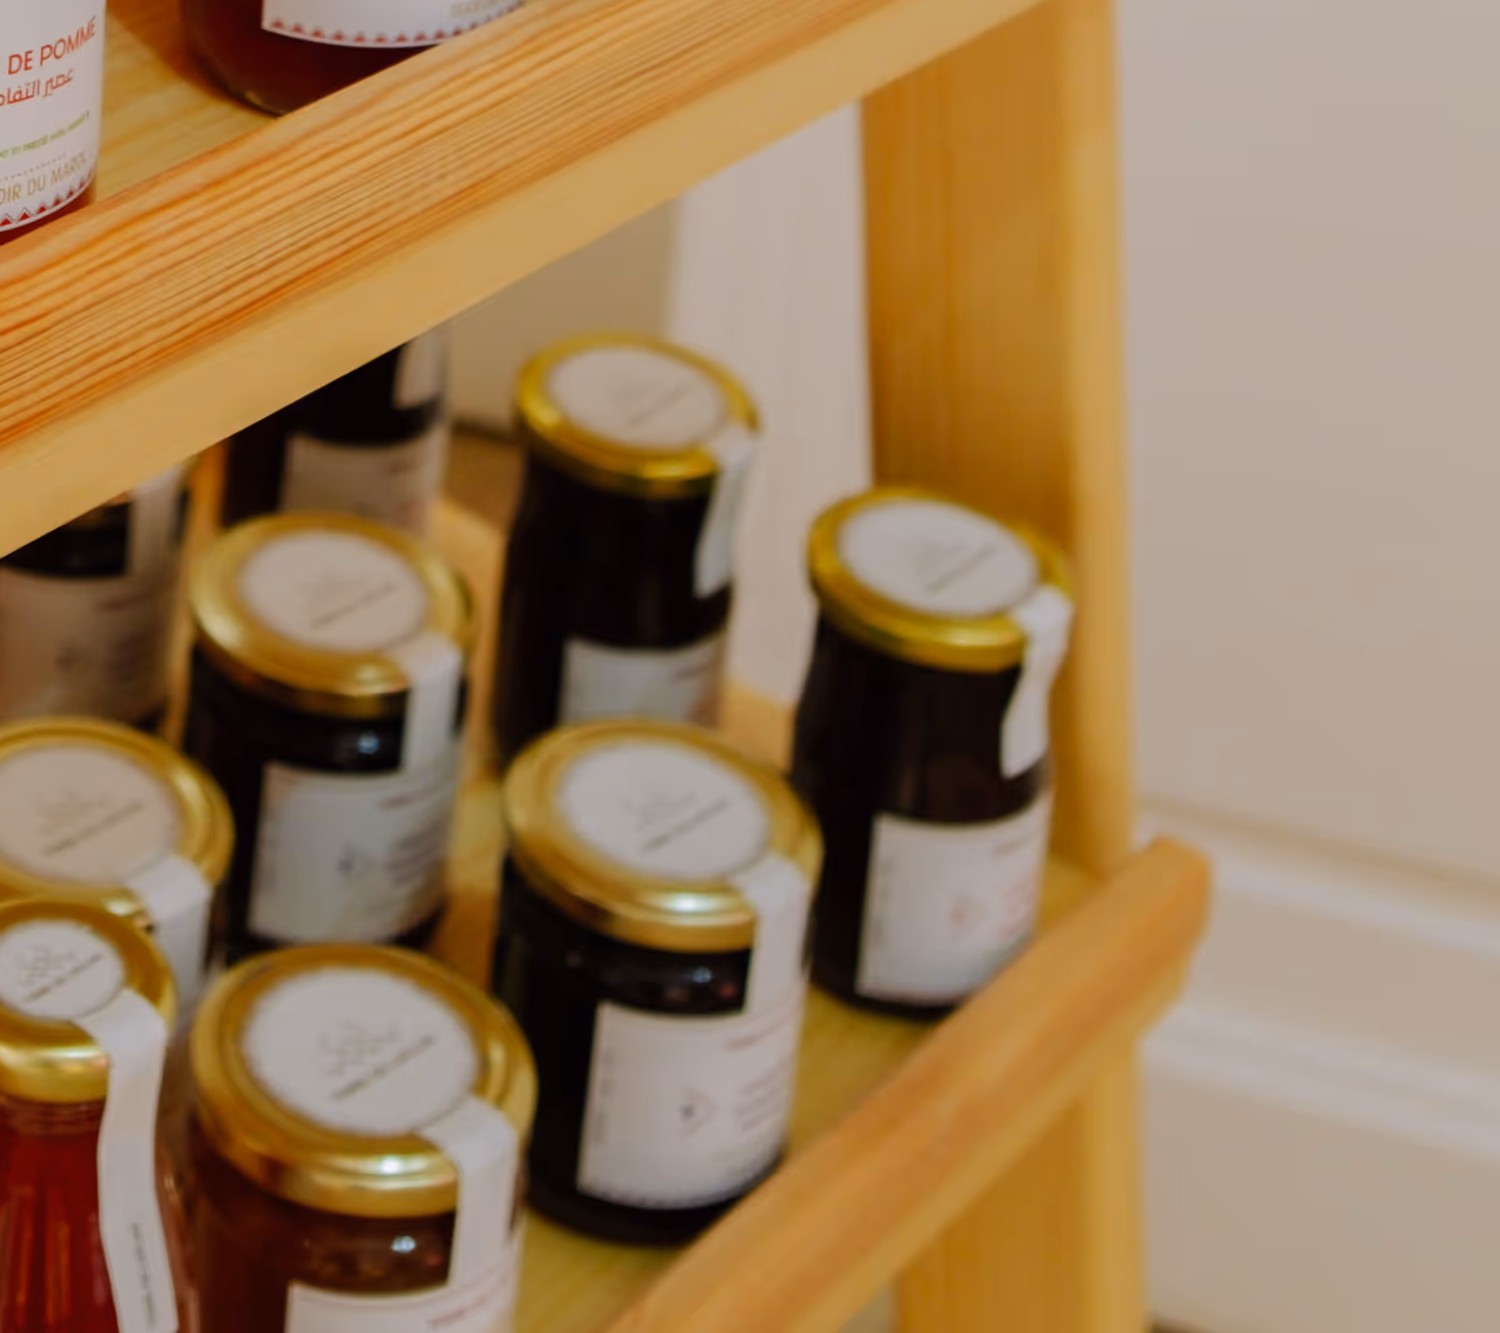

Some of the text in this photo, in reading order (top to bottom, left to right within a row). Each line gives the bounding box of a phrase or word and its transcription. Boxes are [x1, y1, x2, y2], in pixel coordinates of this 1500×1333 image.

[8, 49, 34, 76] DE
[40, 15, 97, 66] POMME
[27, 173, 46, 197] DU
